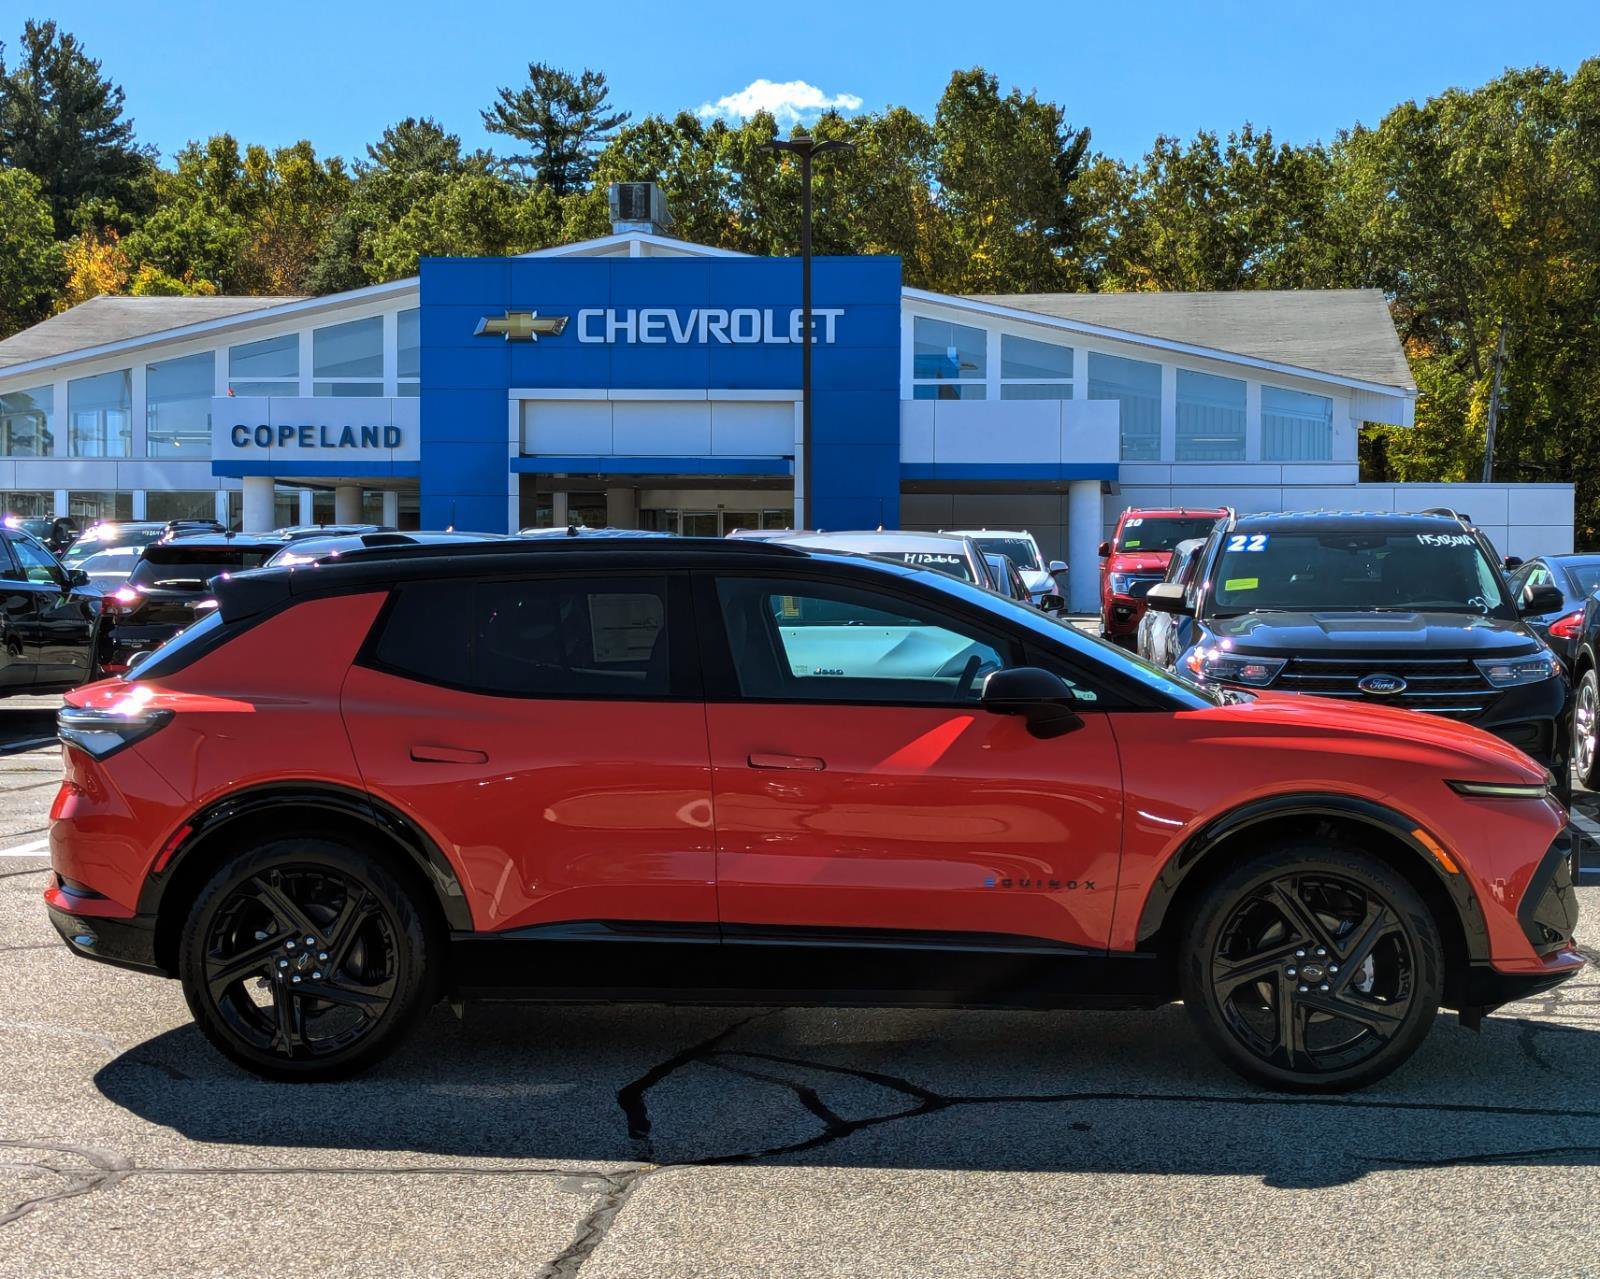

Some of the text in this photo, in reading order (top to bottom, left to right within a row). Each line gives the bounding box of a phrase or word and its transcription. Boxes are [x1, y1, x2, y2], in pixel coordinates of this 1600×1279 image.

[577, 308, 845, 344] CHEVROLET
[231, 424, 402, 448] COPELAND
[1125, 519, 1143, 528] 20
[1229, 534, 1267, 551] 22
[983, 878, 1096, 890] EQUINOX
